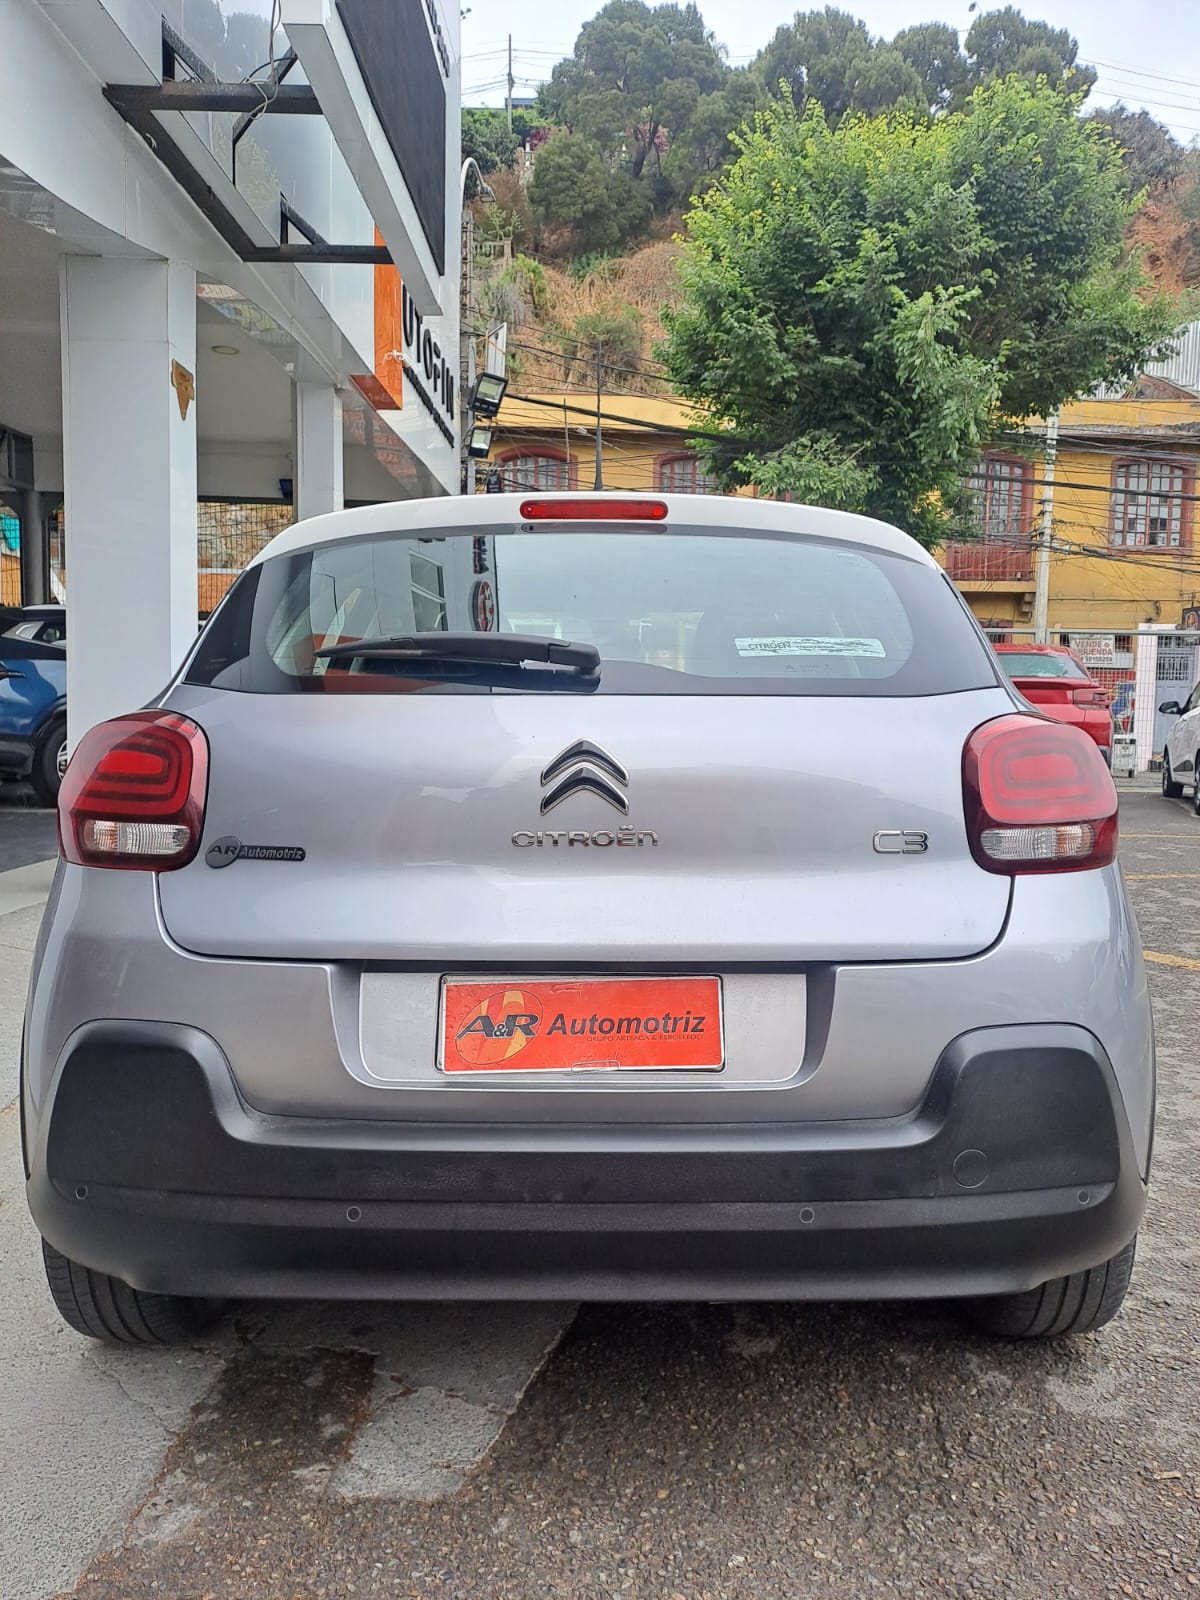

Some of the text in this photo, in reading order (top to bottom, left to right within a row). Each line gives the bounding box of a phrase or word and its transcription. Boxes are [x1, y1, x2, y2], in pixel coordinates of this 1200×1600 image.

[1077, 648, 1113, 656] RRIENDA
[873, 830, 928, 854] C3
[208, 845, 303, 859] AR Automotriz
[456, 1010, 706, 1039] A&R Automotriz
